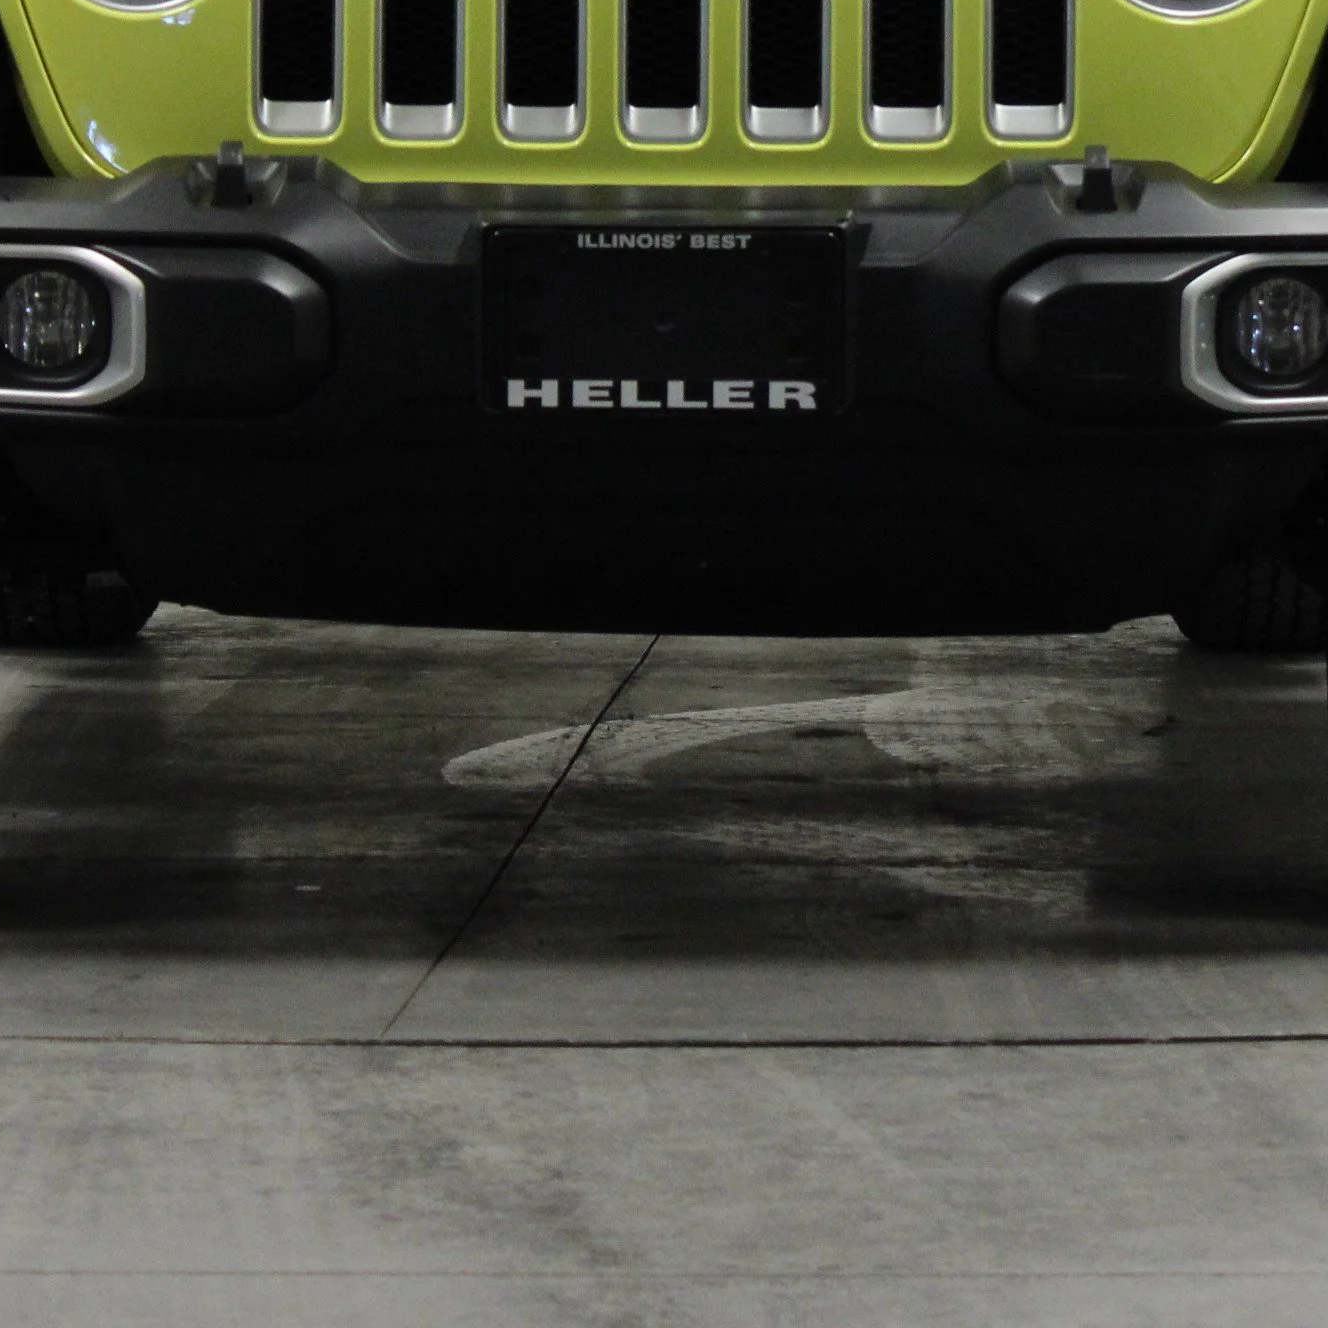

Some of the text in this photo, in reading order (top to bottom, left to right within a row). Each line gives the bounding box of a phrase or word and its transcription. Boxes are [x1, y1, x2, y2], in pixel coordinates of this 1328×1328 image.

[577, 233, 751, 250] ILLINOIS' BEST
[507, 379, 817, 410] HELLER
